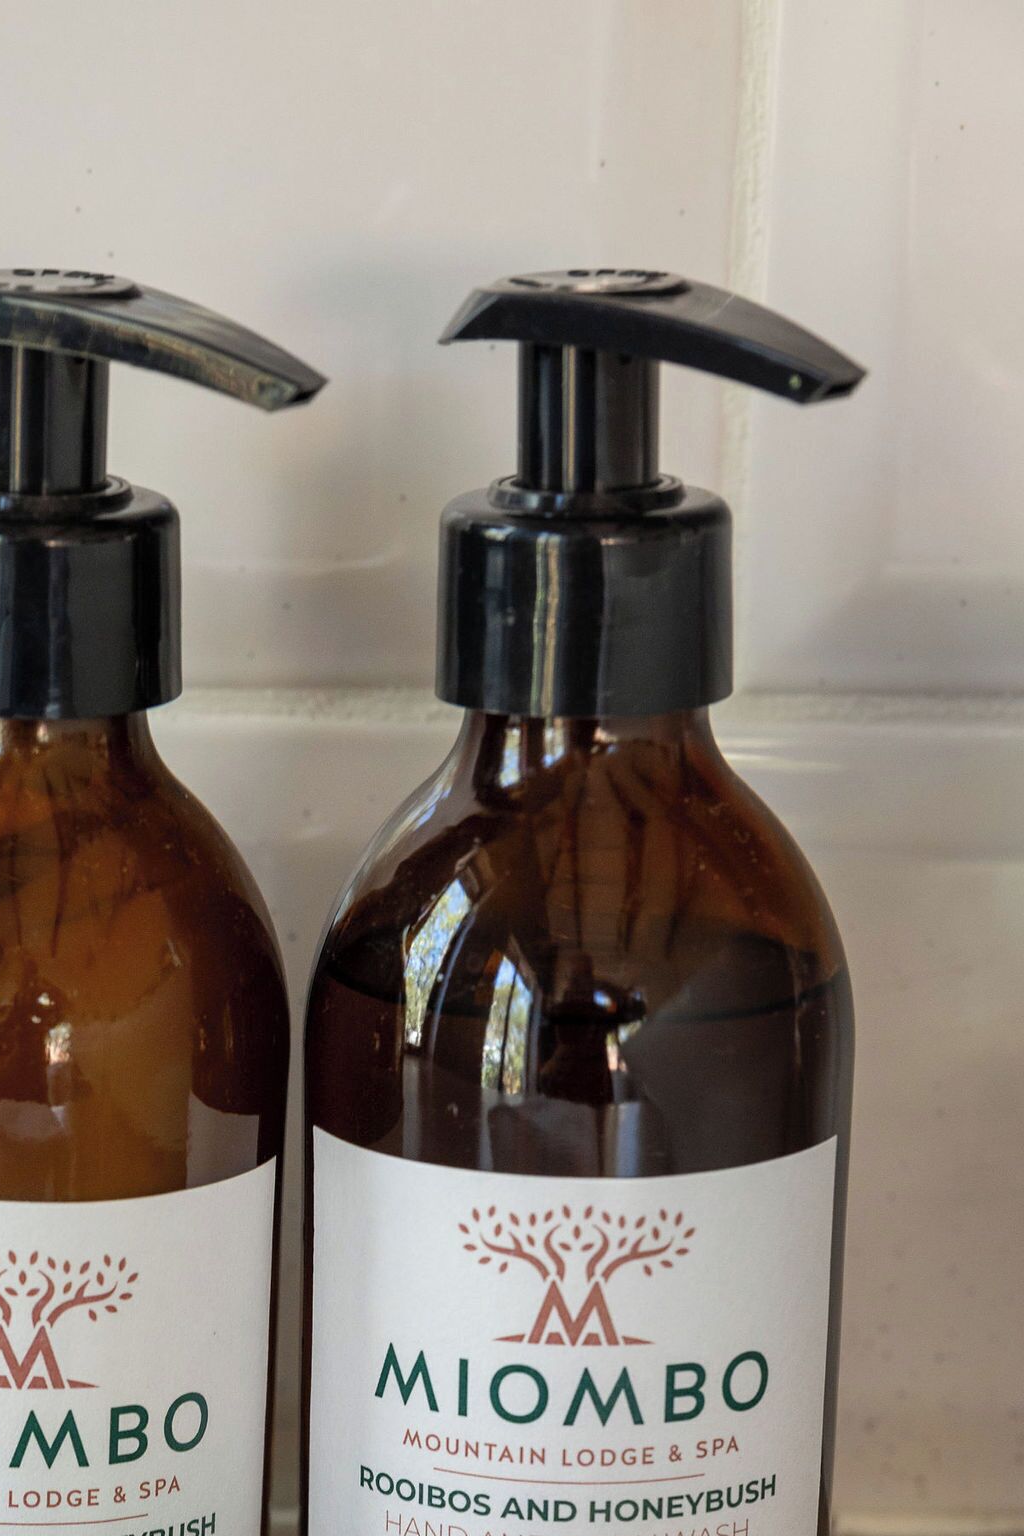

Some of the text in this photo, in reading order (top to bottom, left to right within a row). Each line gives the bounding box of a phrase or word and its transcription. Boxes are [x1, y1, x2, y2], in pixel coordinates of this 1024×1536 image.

[374, 1342, 769, 1428] MIOMBO
[402, 1428, 740, 1468] MOUNTAIN LODGE & SPA
[7, 1487, 101, 1510] LODGE
[112, 1485, 127, 1505] &
[138, 1475, 182, 1503] SPA
[359, 1464, 777, 1524] ROOIBOS AND HONEYBUSH
